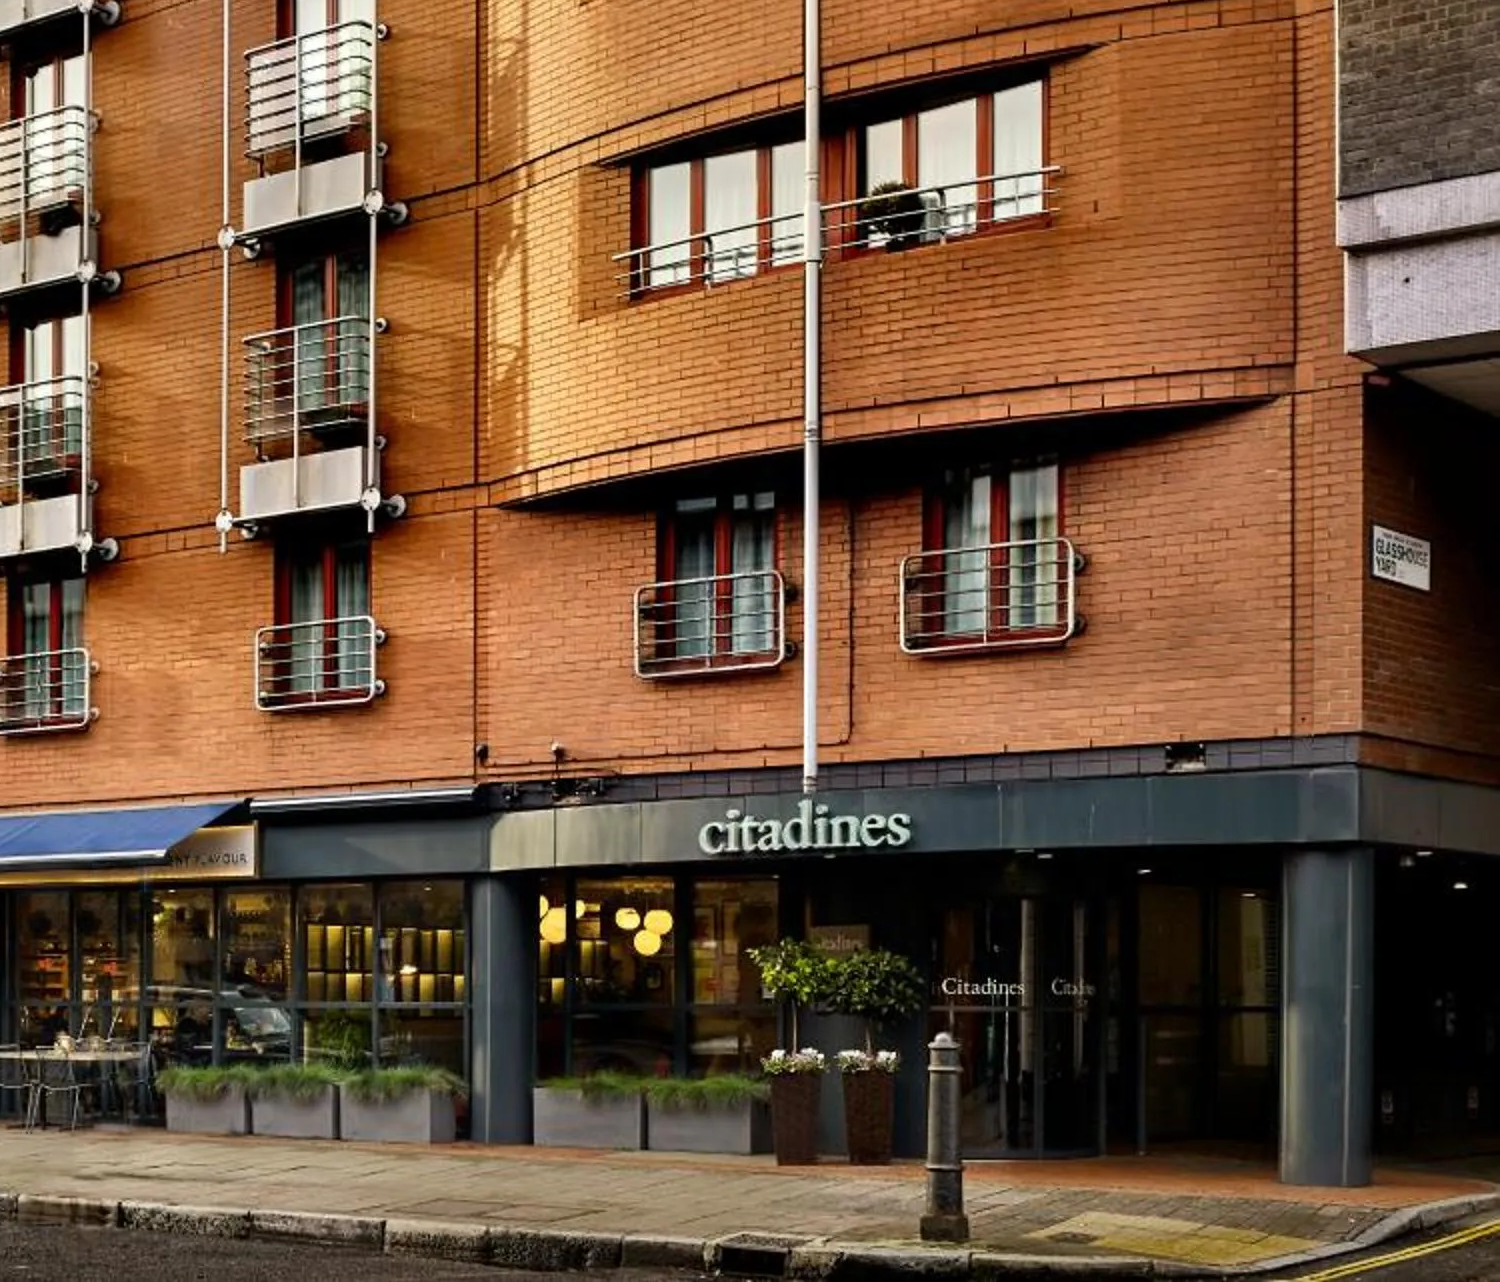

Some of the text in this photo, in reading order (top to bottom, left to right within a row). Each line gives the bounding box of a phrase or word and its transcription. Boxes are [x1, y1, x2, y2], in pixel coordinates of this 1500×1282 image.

[1376, 538, 1428, 569] GLASSHOUSE
[1376, 556, 1396, 576] YARD
[699, 799, 911, 855] citadines
[941, 977, 1025, 995] Citadines
